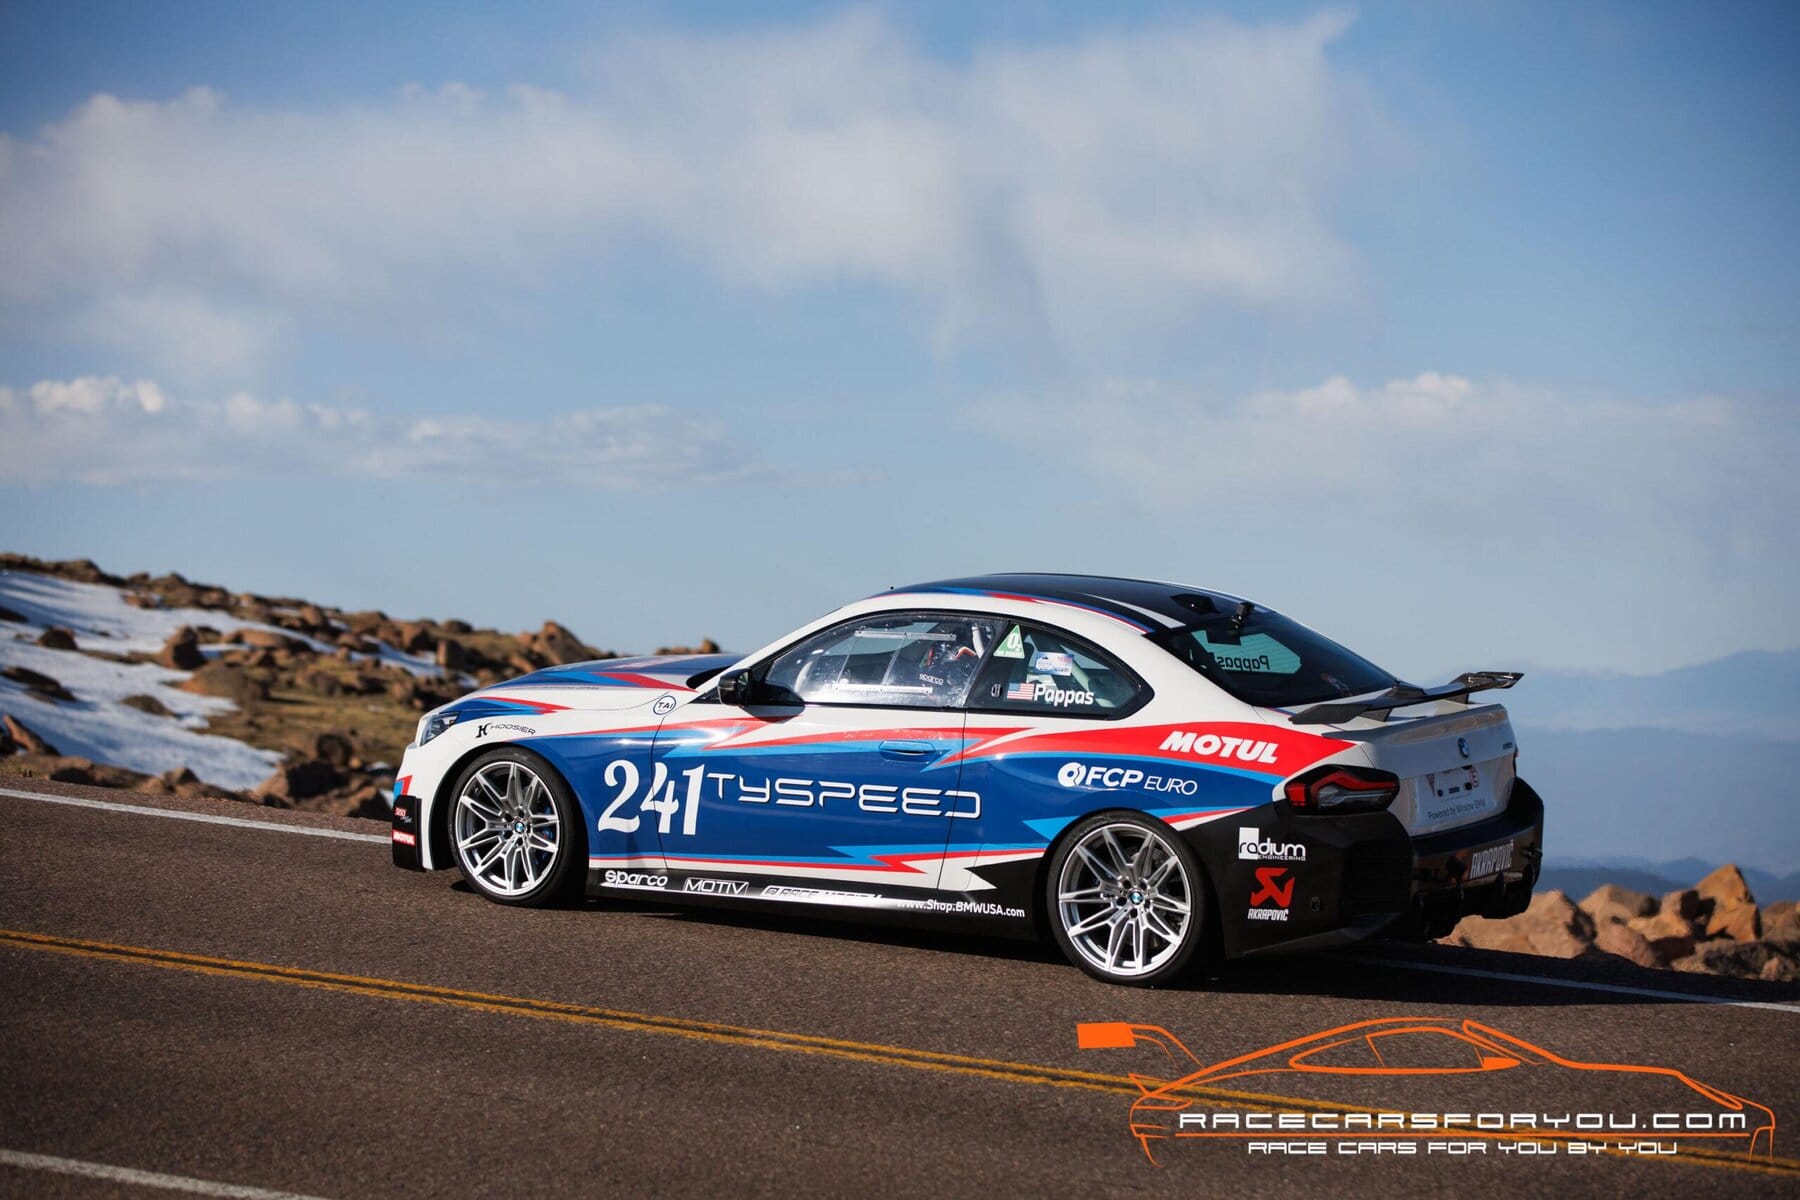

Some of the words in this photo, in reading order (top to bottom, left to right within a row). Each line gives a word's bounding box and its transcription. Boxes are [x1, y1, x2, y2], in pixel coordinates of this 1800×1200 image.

[658, 701, 674, 709] TAI
[1034, 683, 1094, 707] Pappas
[490, 723, 537, 736] HOOSIER
[1158, 730, 1279, 764] MOTUL
[1085, 766, 1144, 788] FCP
[1144, 775, 1198, 796] EURO
[598, 759, 705, 836] 241
[706, 771, 982, 820] TYSPEED
[1239, 837, 1306, 857] radium
[604, 869, 668, 887] sparco
[685, 879, 748, 895] MOTIV
